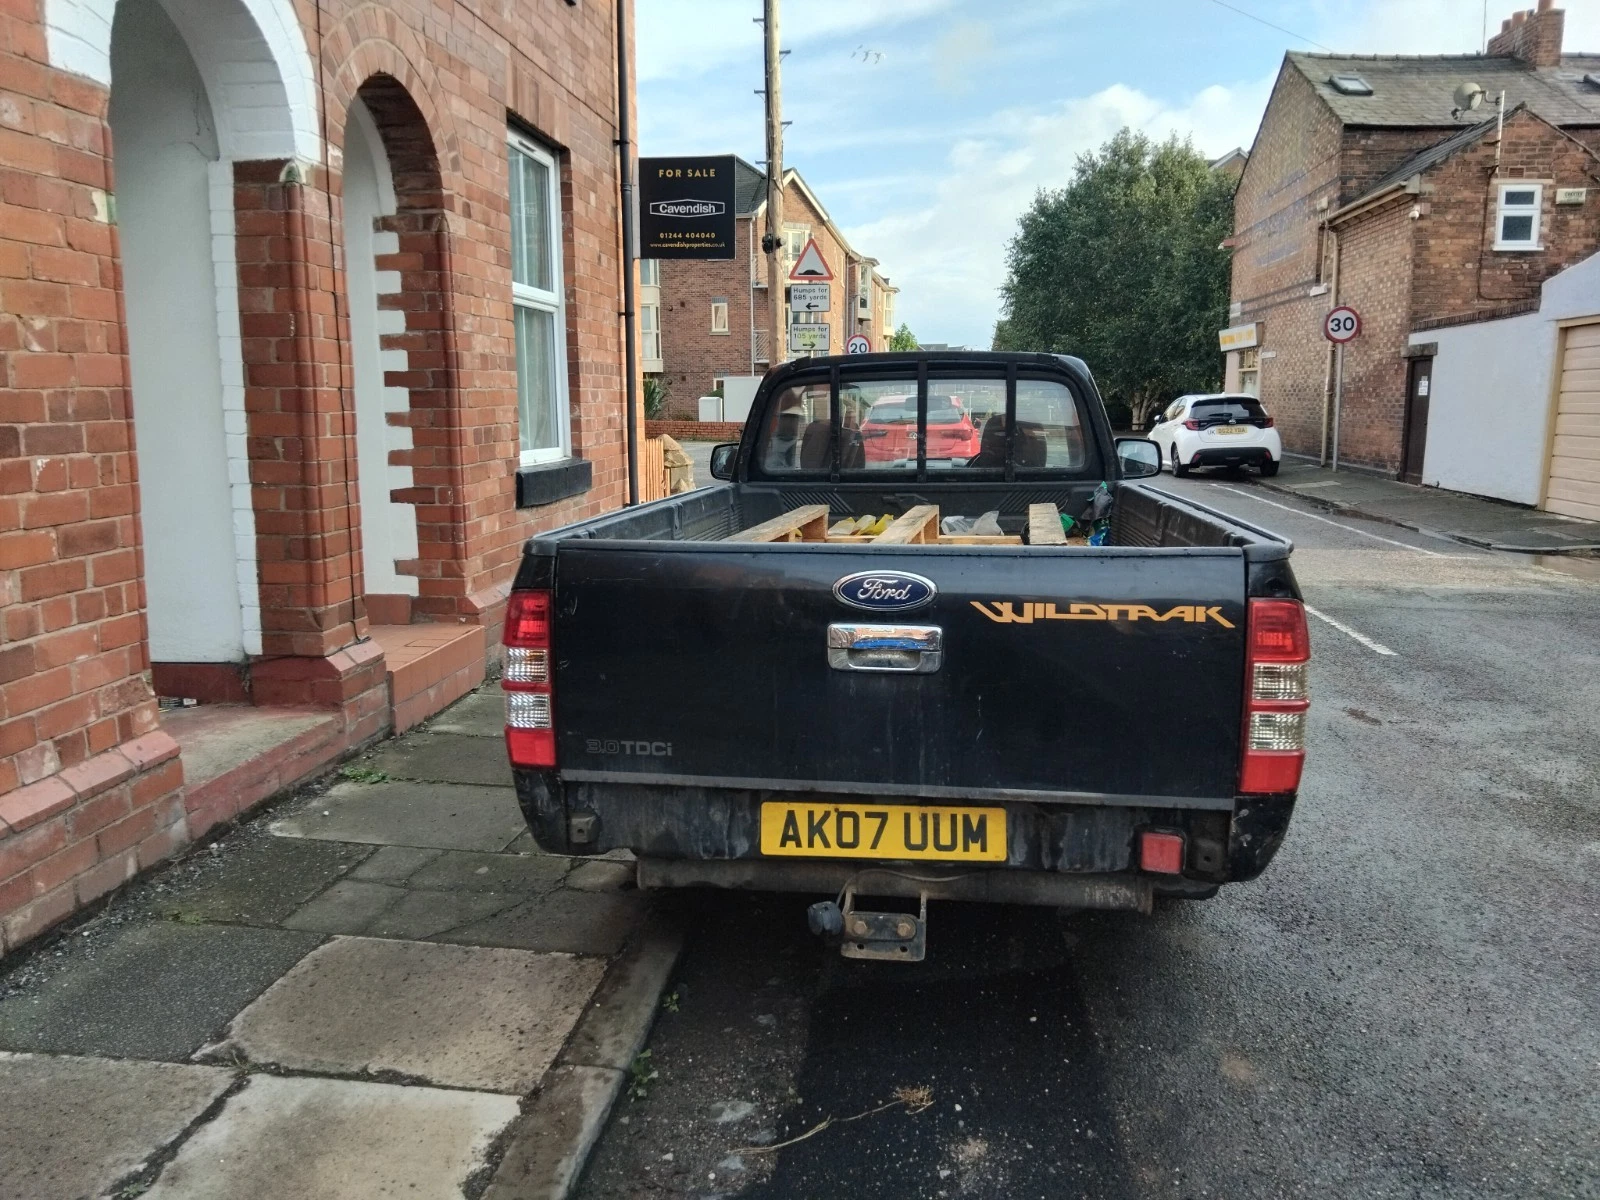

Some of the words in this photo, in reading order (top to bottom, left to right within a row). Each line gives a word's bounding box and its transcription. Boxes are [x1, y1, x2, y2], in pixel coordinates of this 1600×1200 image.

[658, 169, 682, 178] FOR
[687, 168, 716, 177] SALE
[659, 203, 716, 214] Cavendish
[650, 241, 725, 249] www.cavendishproperties.co.uk
[1330, 316, 1355, 333] 30
[850, 342, 868, 354] 20
[857, 578, 912, 600] Ford
[969, 601, 1236, 629] WILDTRAK
[779, 809, 889, 850] AK07
[903, 811, 988, 853] UUM
